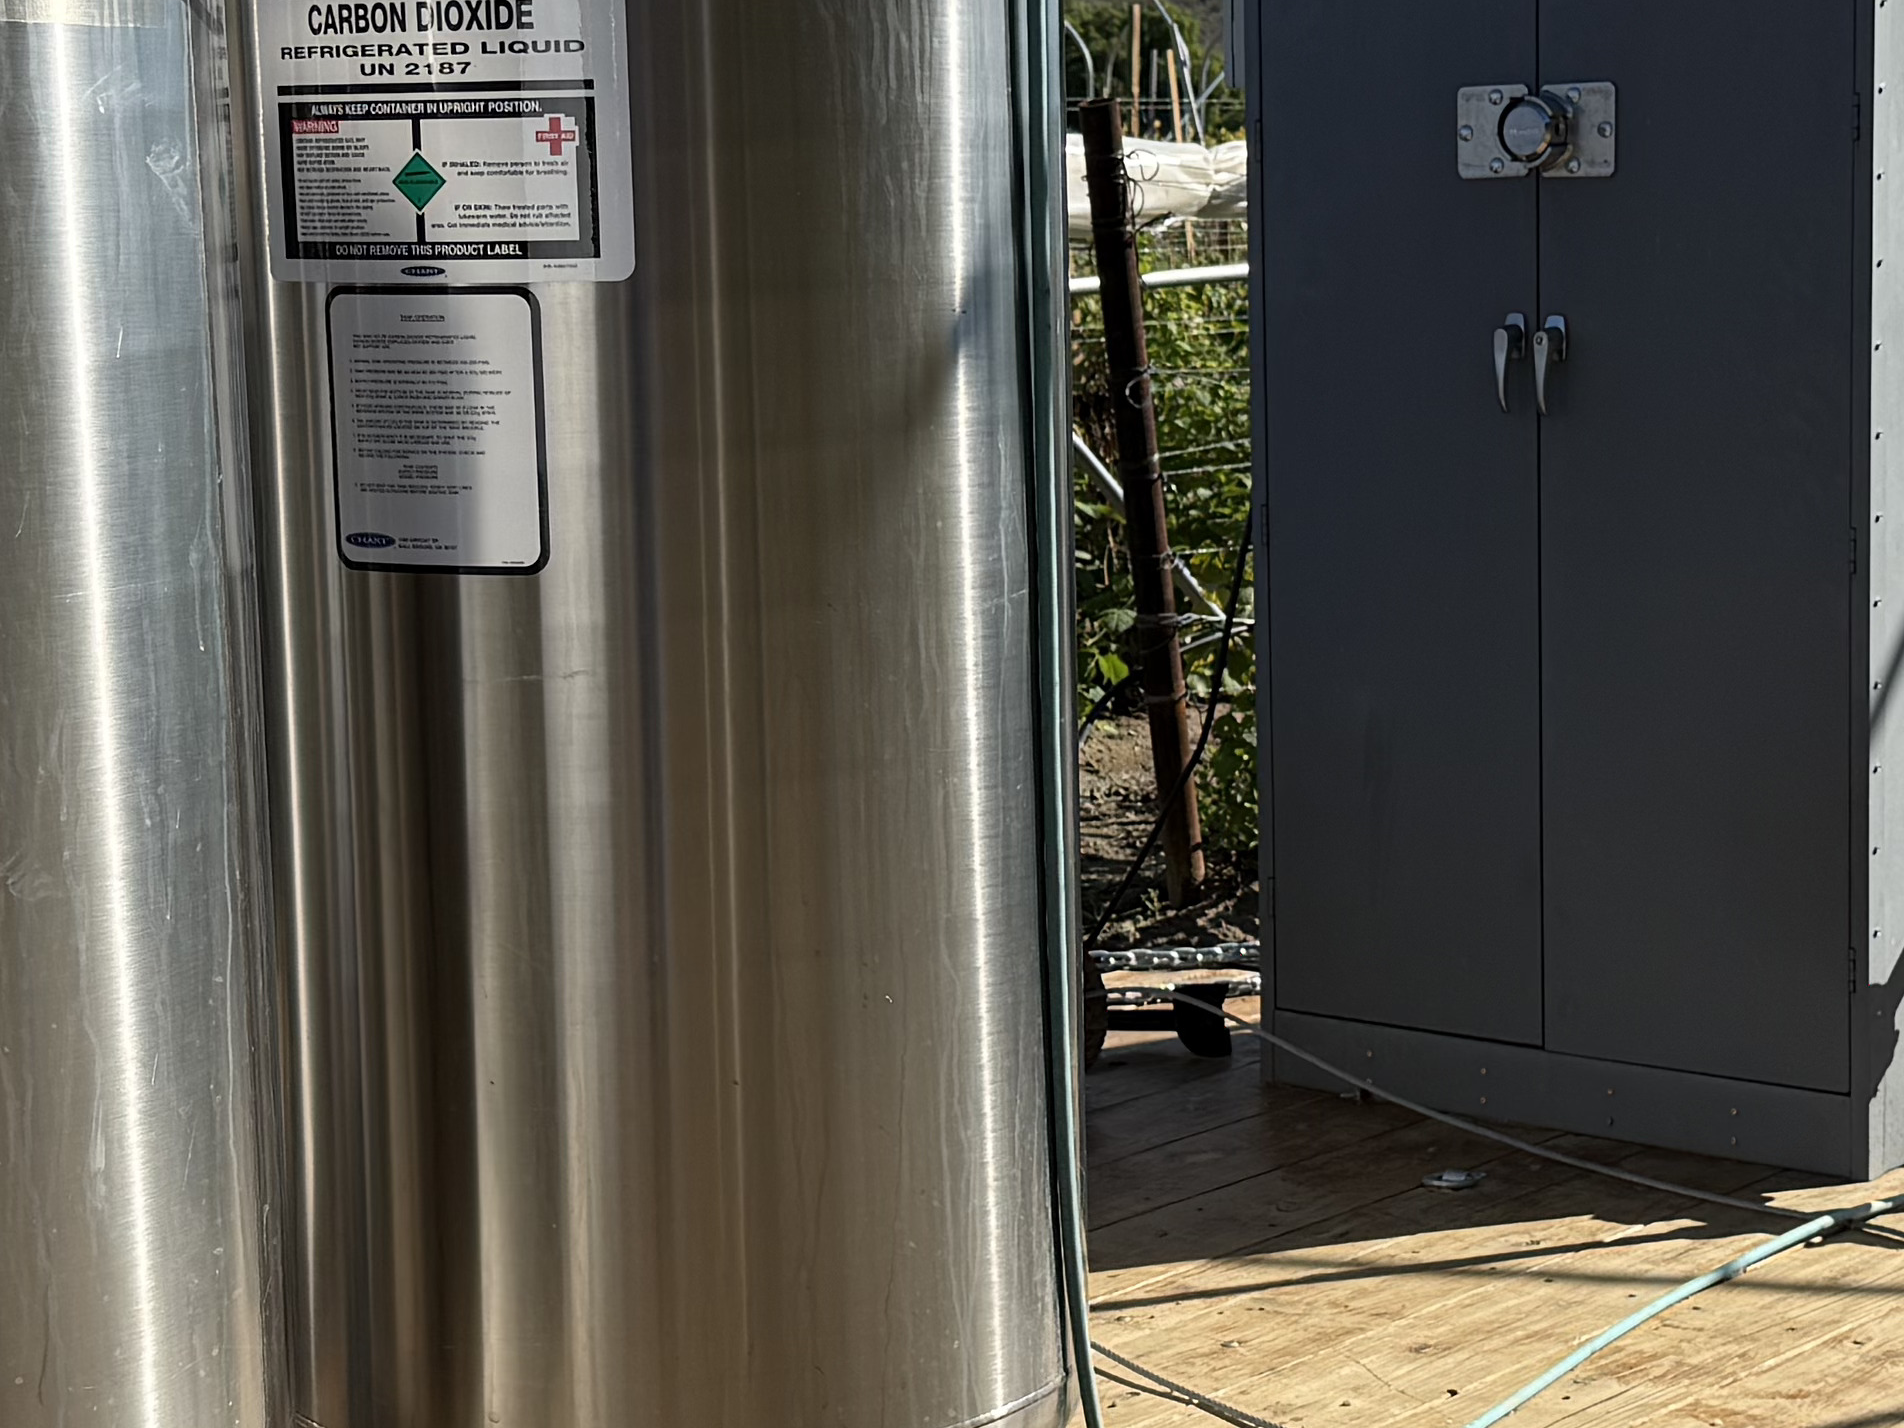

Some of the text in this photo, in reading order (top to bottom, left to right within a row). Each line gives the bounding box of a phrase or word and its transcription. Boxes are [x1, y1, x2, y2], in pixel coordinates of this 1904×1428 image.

[308, 0, 534, 36] CARBON DIOXIDE
[280, 38, 586, 60] REFRIGERATED LIQUID
[360, 60, 471, 76] UN 2187
[345, 104, 369, 115] KEEP
[370, 102, 425, 115] CONTAINER
[427, 102, 437, 114] IN
[439, 101, 485, 114] UPRIGHT
[488, 100, 543, 113] POSITION.
[537, 132, 575, 141] FIRST AID
[335, 243, 523, 256] DO NOT REMOVE THIS PRODUCT LABEL
